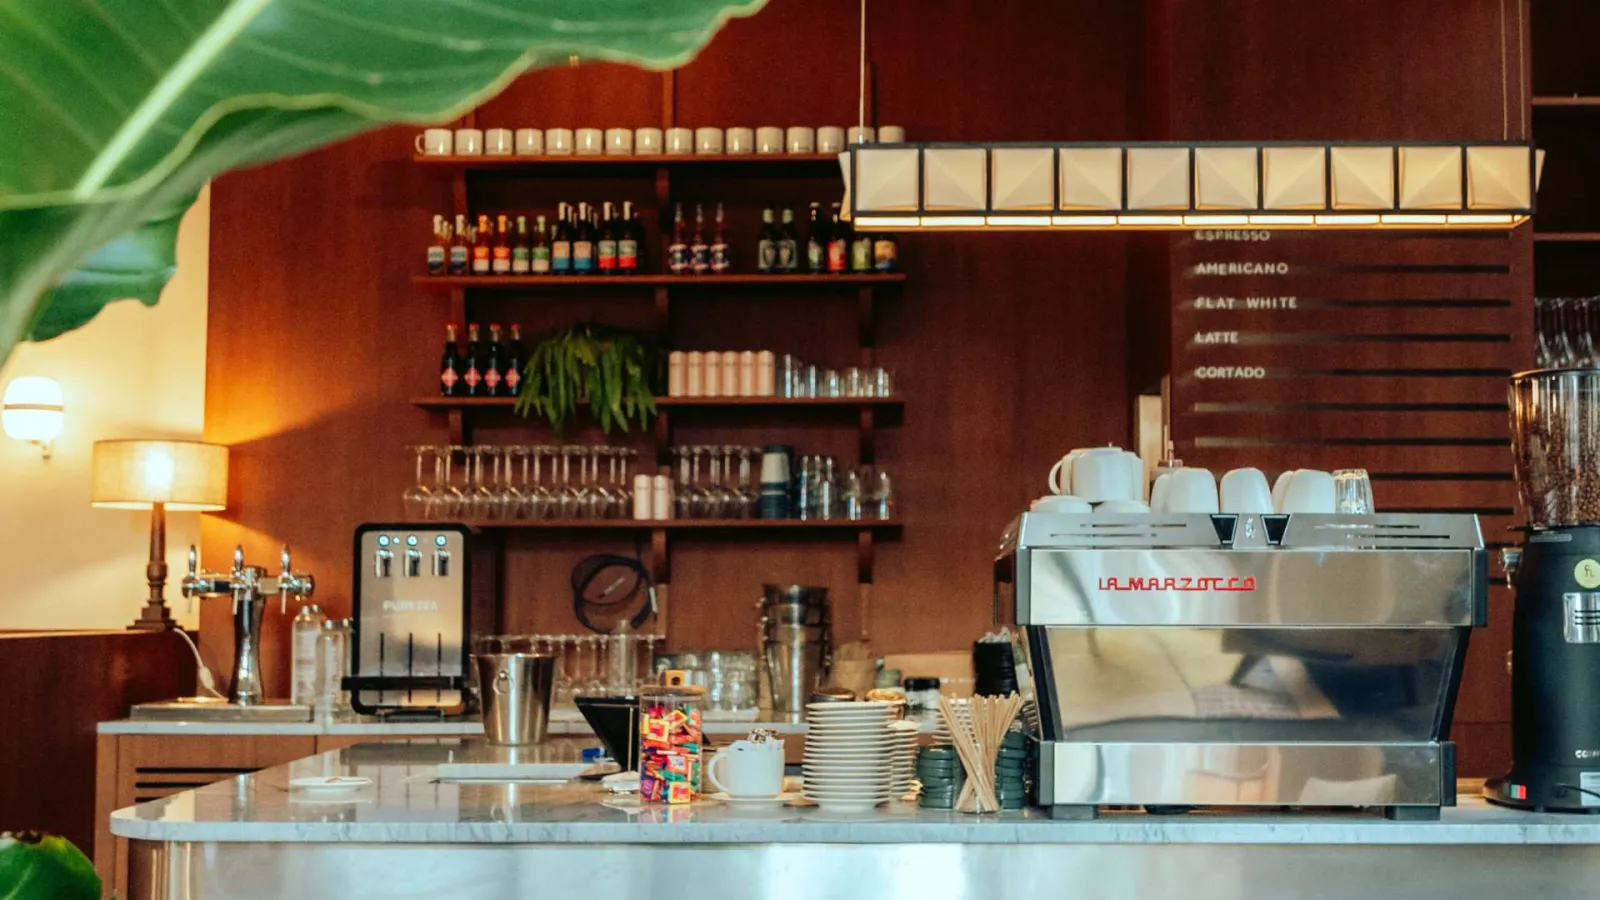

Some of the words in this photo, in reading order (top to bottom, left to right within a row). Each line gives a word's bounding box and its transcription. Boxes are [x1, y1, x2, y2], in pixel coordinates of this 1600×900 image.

[1194, 230, 1271, 242] ESPRESSO
[1194, 262, 1289, 275] AMERICANO
[1194, 296, 1235, 309] FLAT
[1246, 296, 1298, 309] WHITE
[1194, 331, 1239, 344] LATTE
[1194, 366, 1266, 379] CORTADO
[1098, 576, 1119, 591] LA
[1129, 576, 1257, 591] MARZOCCO
